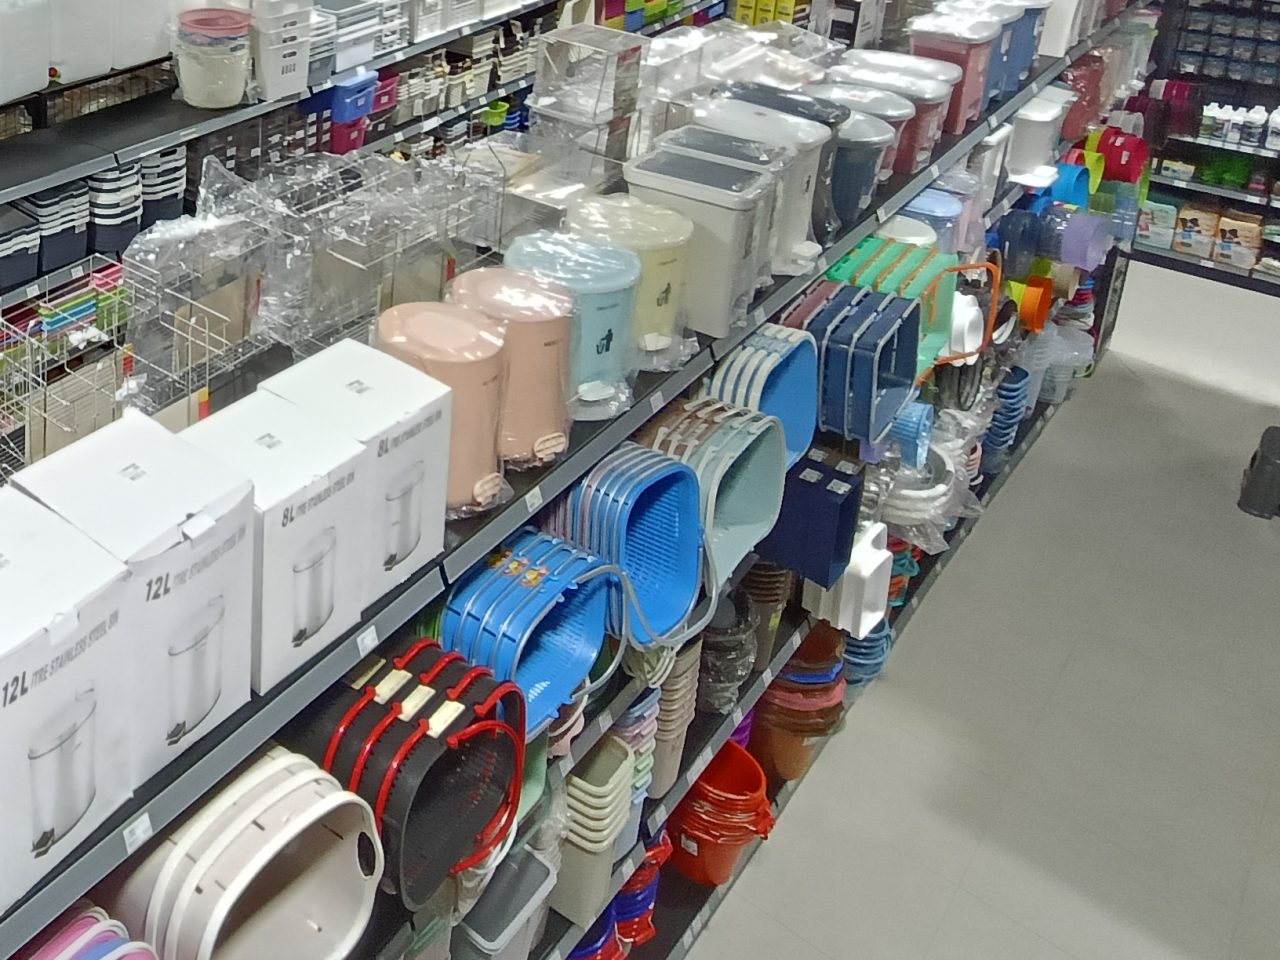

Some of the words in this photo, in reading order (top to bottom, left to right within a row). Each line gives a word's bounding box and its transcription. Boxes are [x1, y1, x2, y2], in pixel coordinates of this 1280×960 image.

[376, 436, 390, 458] 8L
[281, 504, 295, 528] 8L
[145, 571, 171, 602] 12L
[2, 670, 29, 708] 12L
